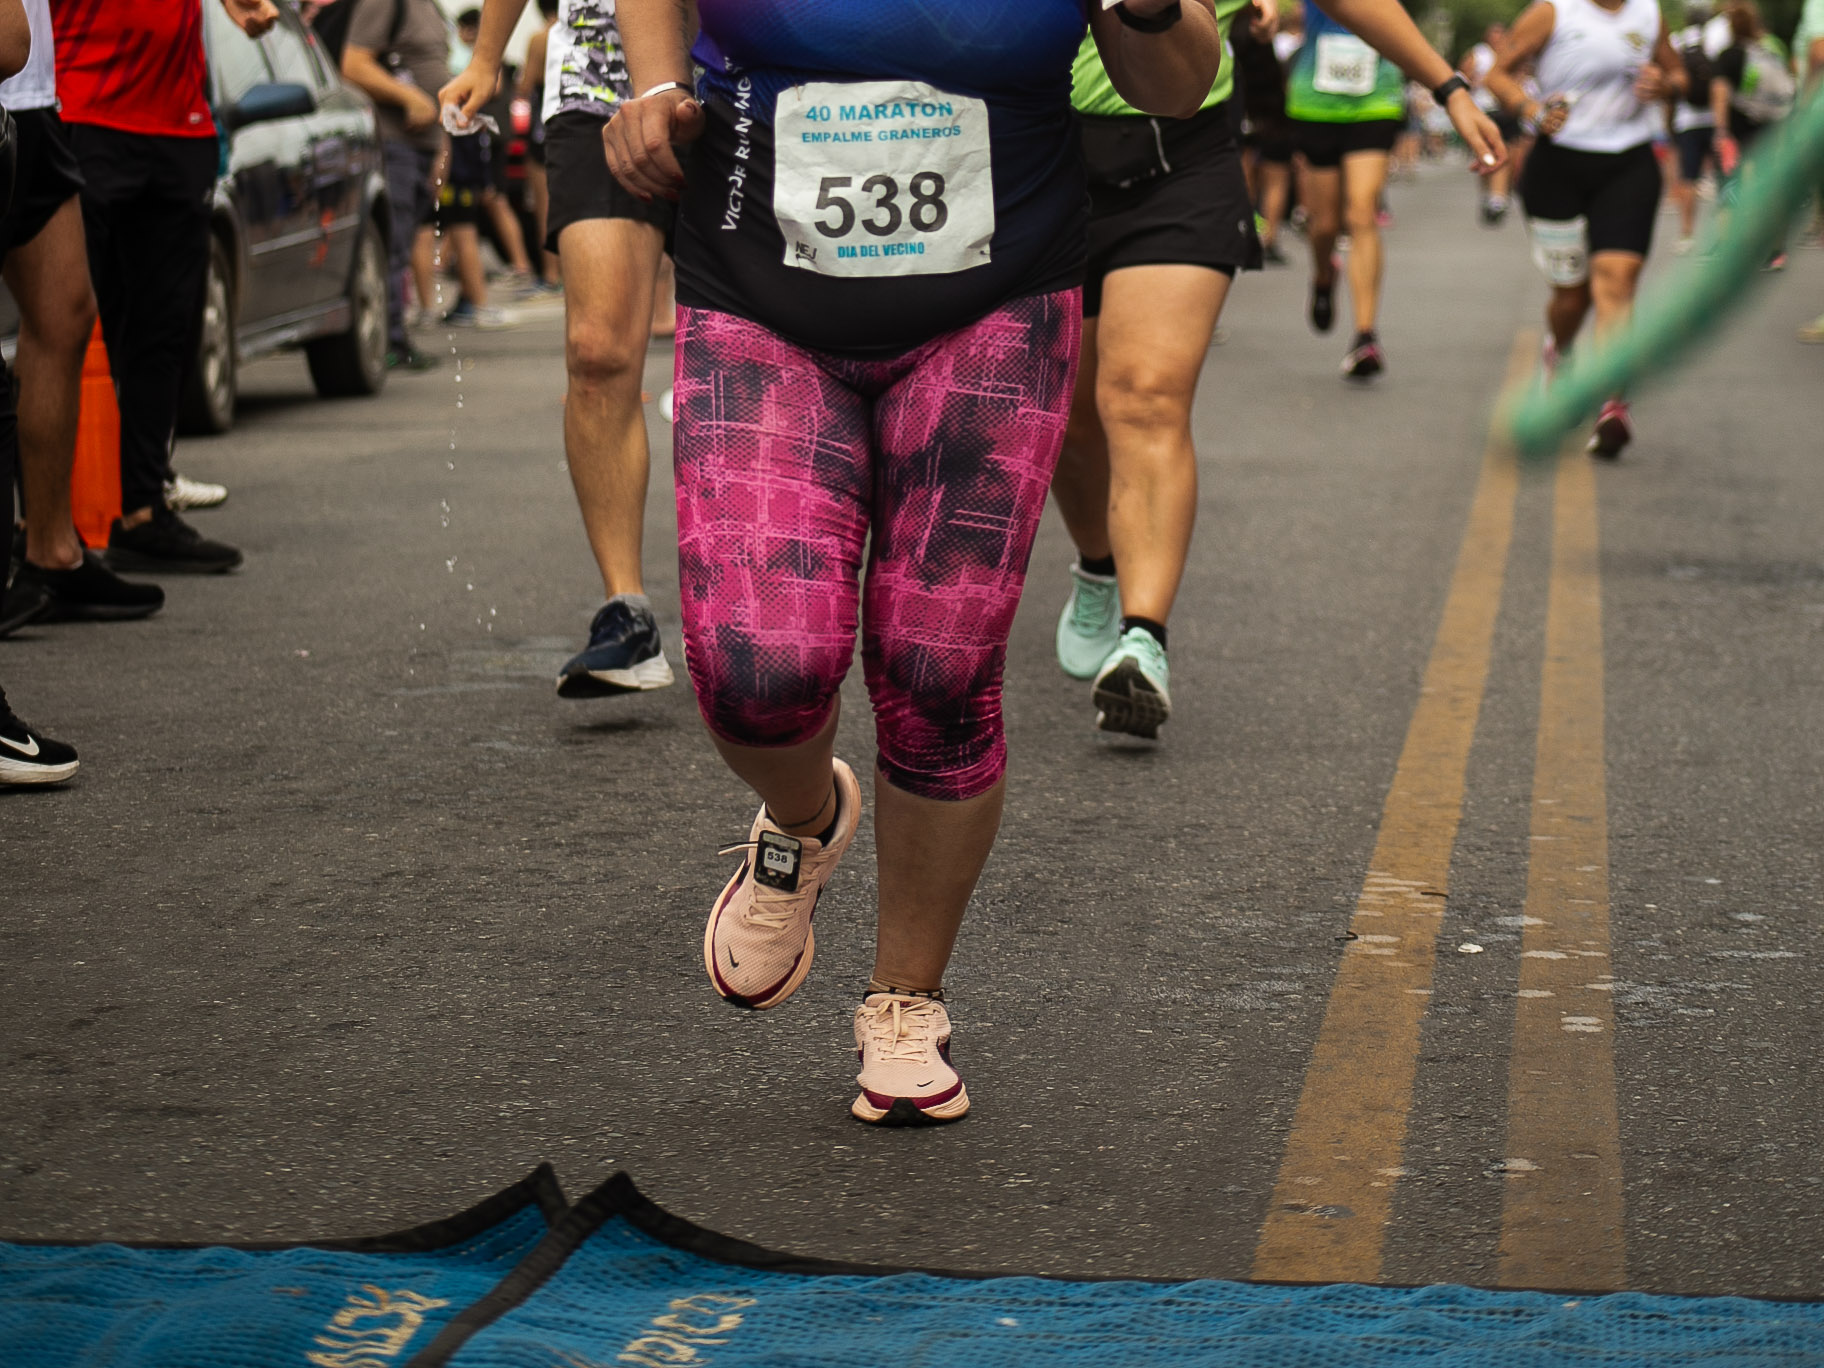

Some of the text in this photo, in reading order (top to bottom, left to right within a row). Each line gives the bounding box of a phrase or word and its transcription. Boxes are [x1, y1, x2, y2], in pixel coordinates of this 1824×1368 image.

[805, 101, 954, 122] 40 MARATON
[802, 125, 962, 144] EMPALME GRANEROS
[813, 170, 949, 239] 538
[836, 241, 926, 259] DIA DEL VECINO
[767, 851, 788, 864] 538
